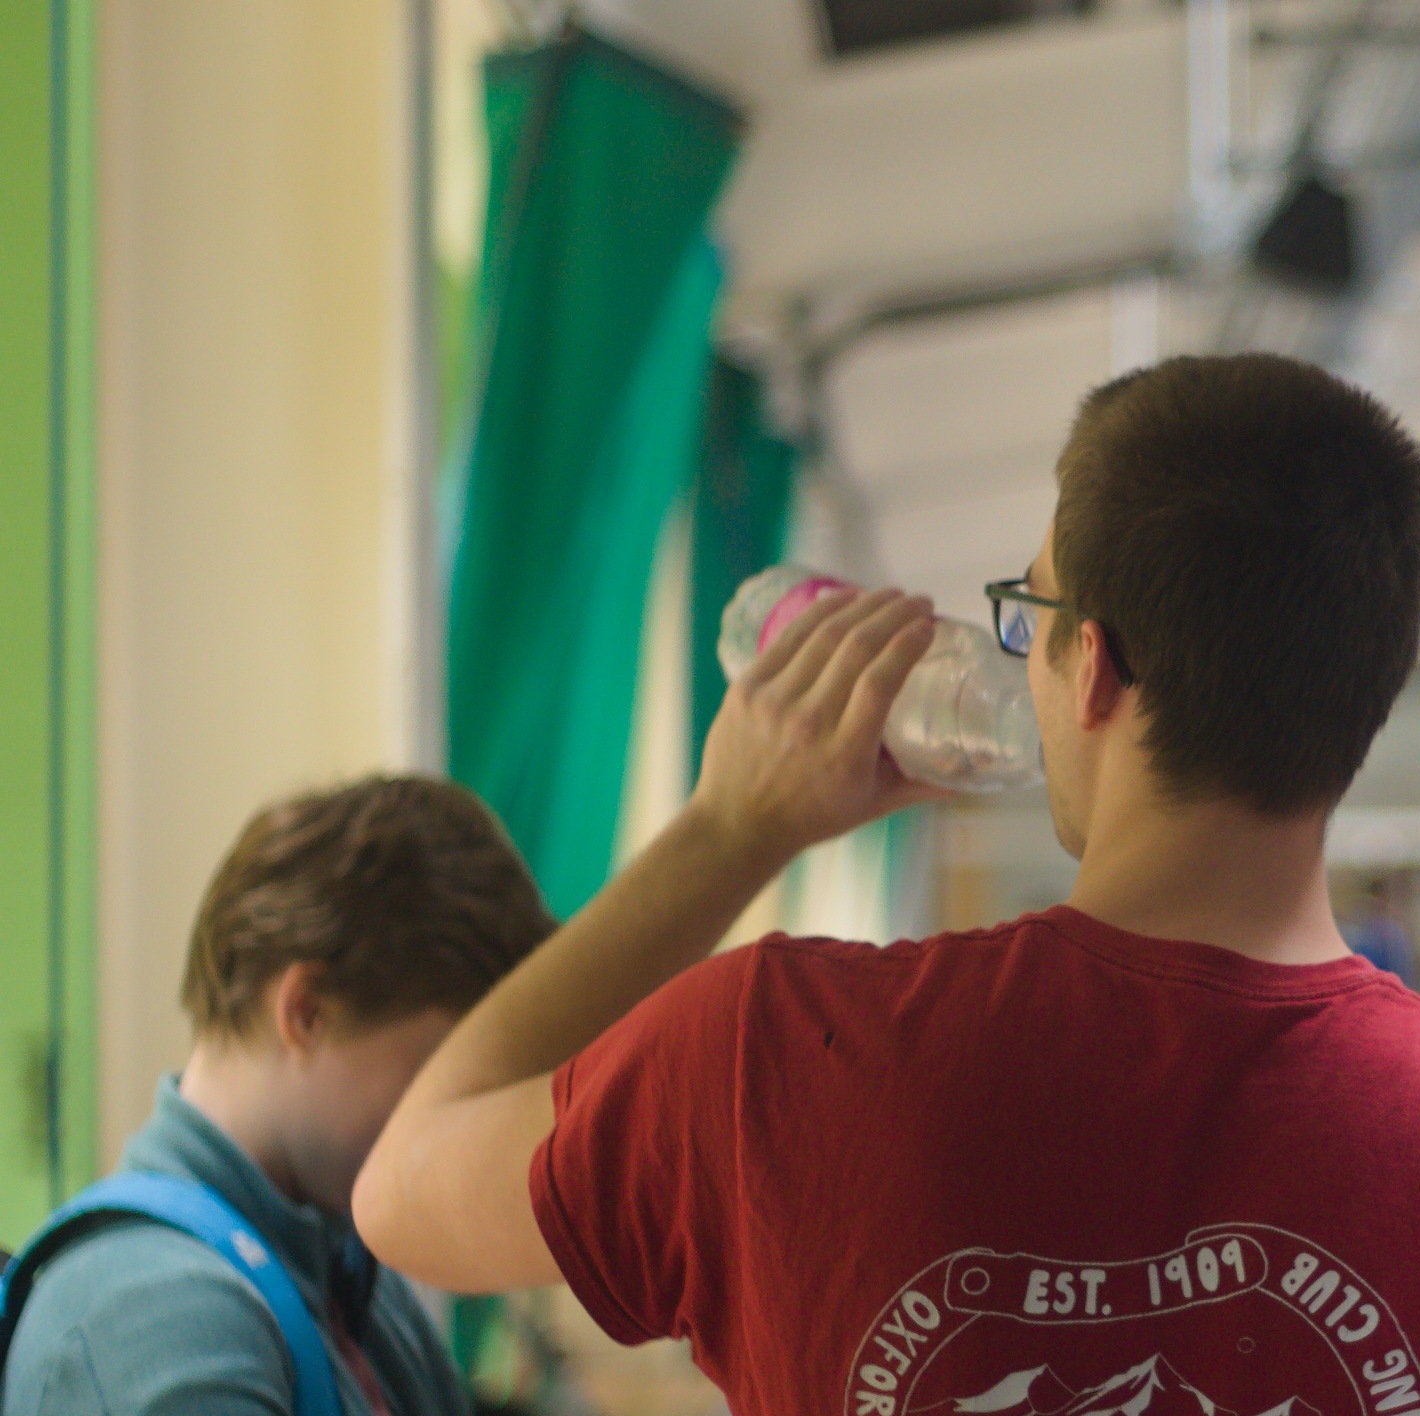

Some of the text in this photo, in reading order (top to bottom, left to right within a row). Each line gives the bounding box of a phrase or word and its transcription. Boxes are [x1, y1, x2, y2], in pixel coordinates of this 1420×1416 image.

[1024, 1239, 1246, 1315] EST. 1909
[1281, 1253, 1380, 1343] CLUB
